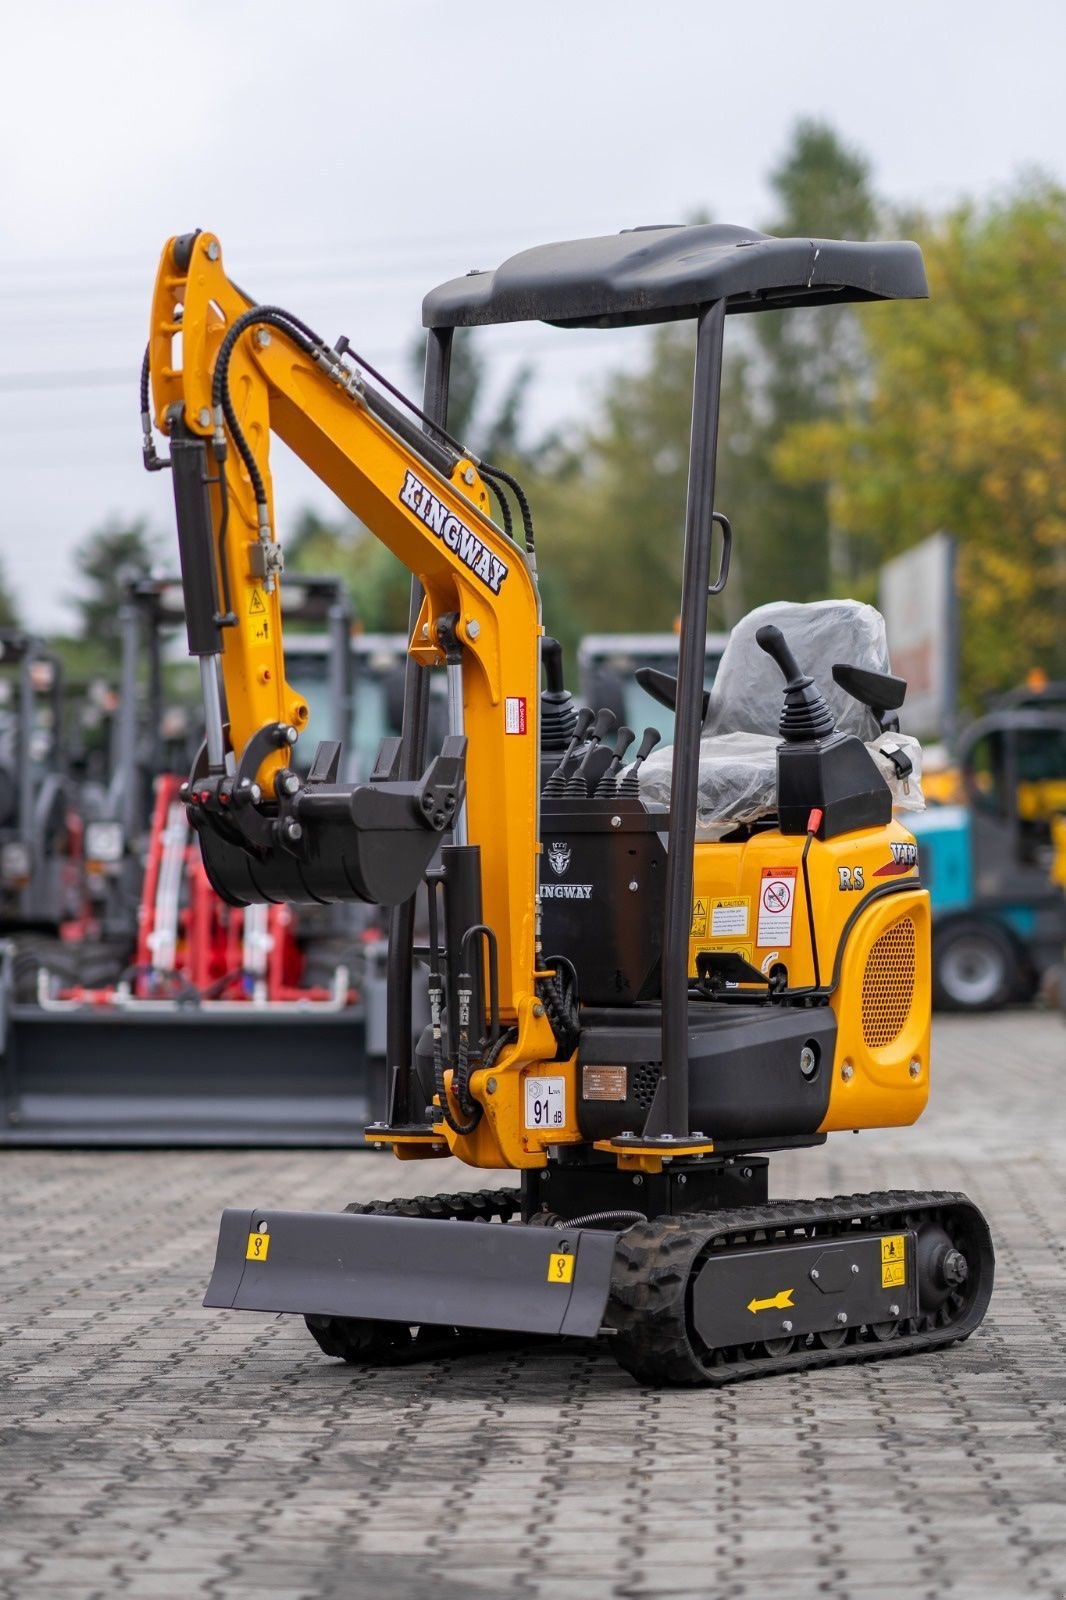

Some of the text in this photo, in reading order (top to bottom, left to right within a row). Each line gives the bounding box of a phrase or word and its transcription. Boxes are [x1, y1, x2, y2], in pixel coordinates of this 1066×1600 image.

[399, 469, 509, 596] KINGWAY
[891, 843, 918, 866] VIP
[838, 866, 865, 891] RS
[539, 885, 593, 899] INGWAY
[534, 1099, 562, 1124] 91 dB
